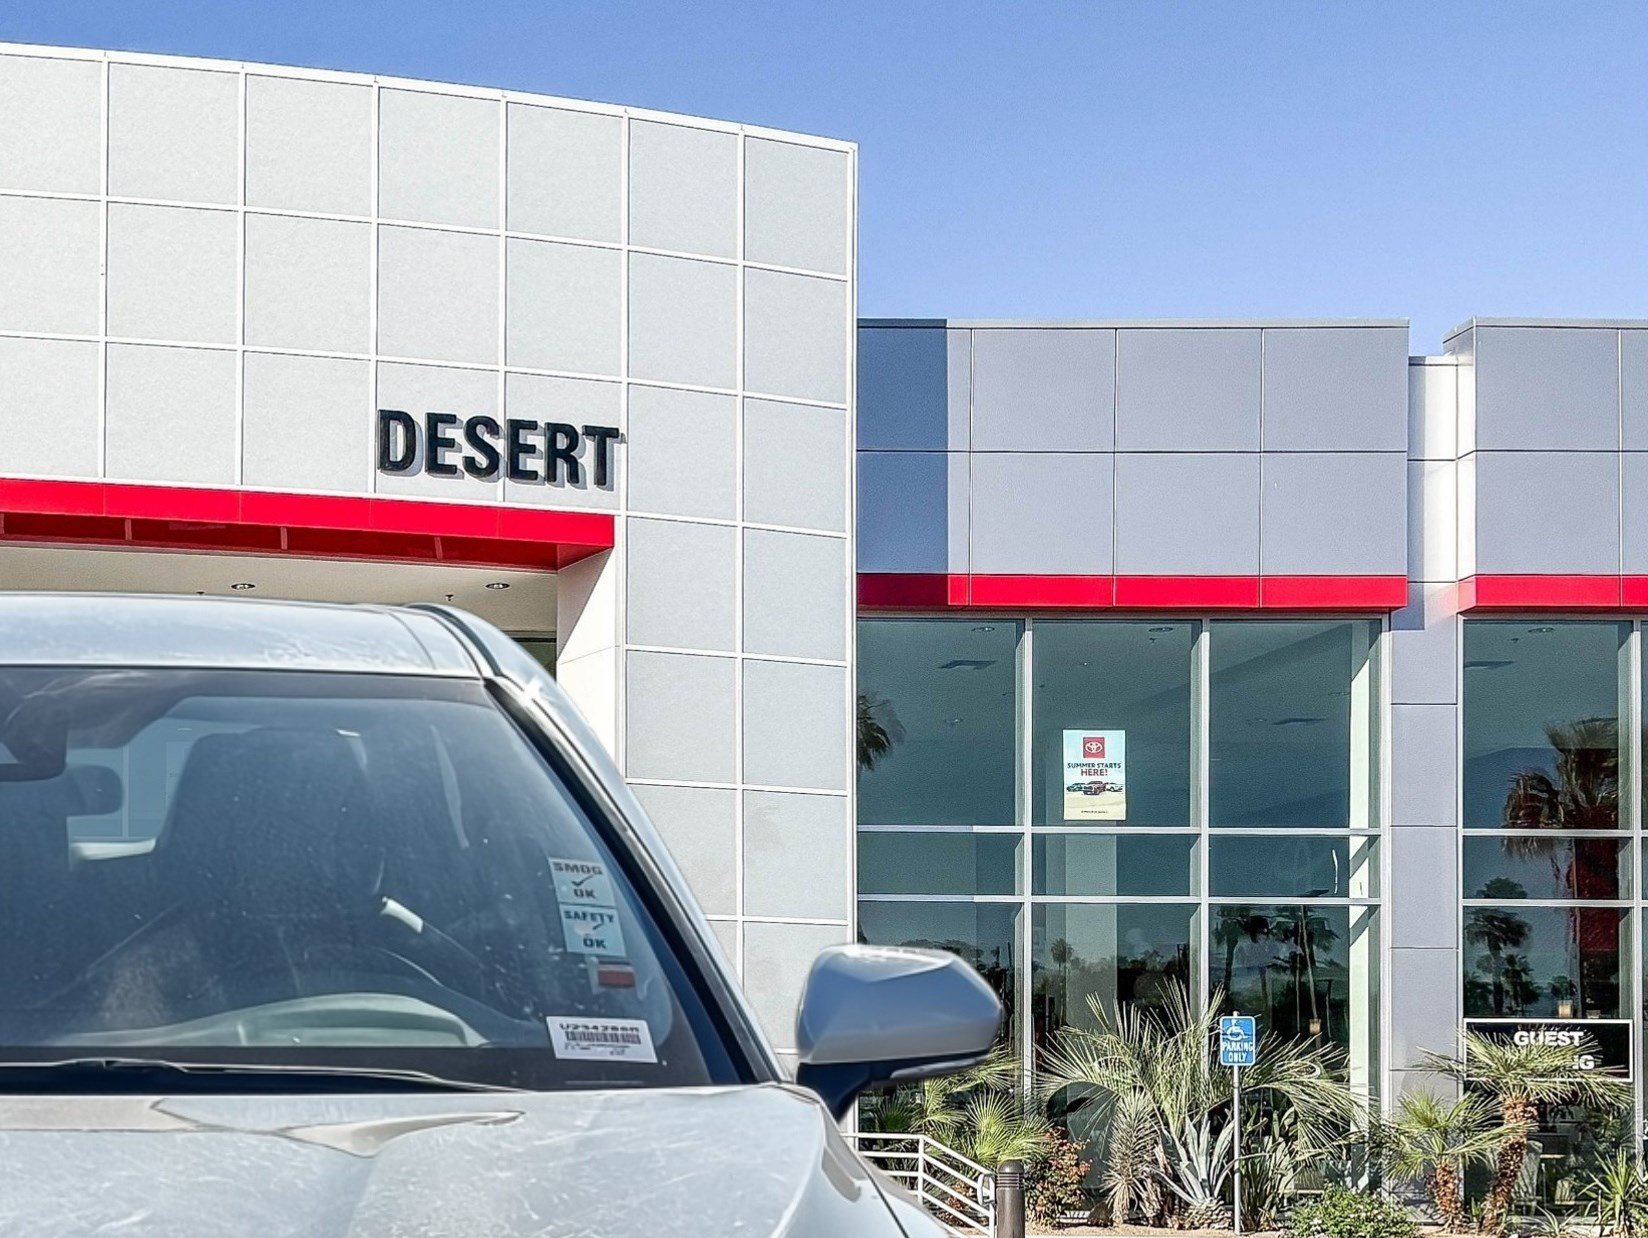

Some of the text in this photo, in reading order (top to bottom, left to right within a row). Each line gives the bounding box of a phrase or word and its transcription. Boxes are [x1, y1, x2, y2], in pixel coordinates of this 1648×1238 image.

[377, 409, 620, 487] DESERT
[1081, 768, 1108, 777] HERE!
[552, 862, 603, 875] SMOG
[573, 888, 597, 899] OK
[563, 910, 614, 922] SAFETY
[583, 938, 607, 949] OK
[1513, 1030, 1584, 1046] GUEST
[1222, 1041, 1253, 1051] PARKING
[1228, 1052, 1247, 1062] ONLY
